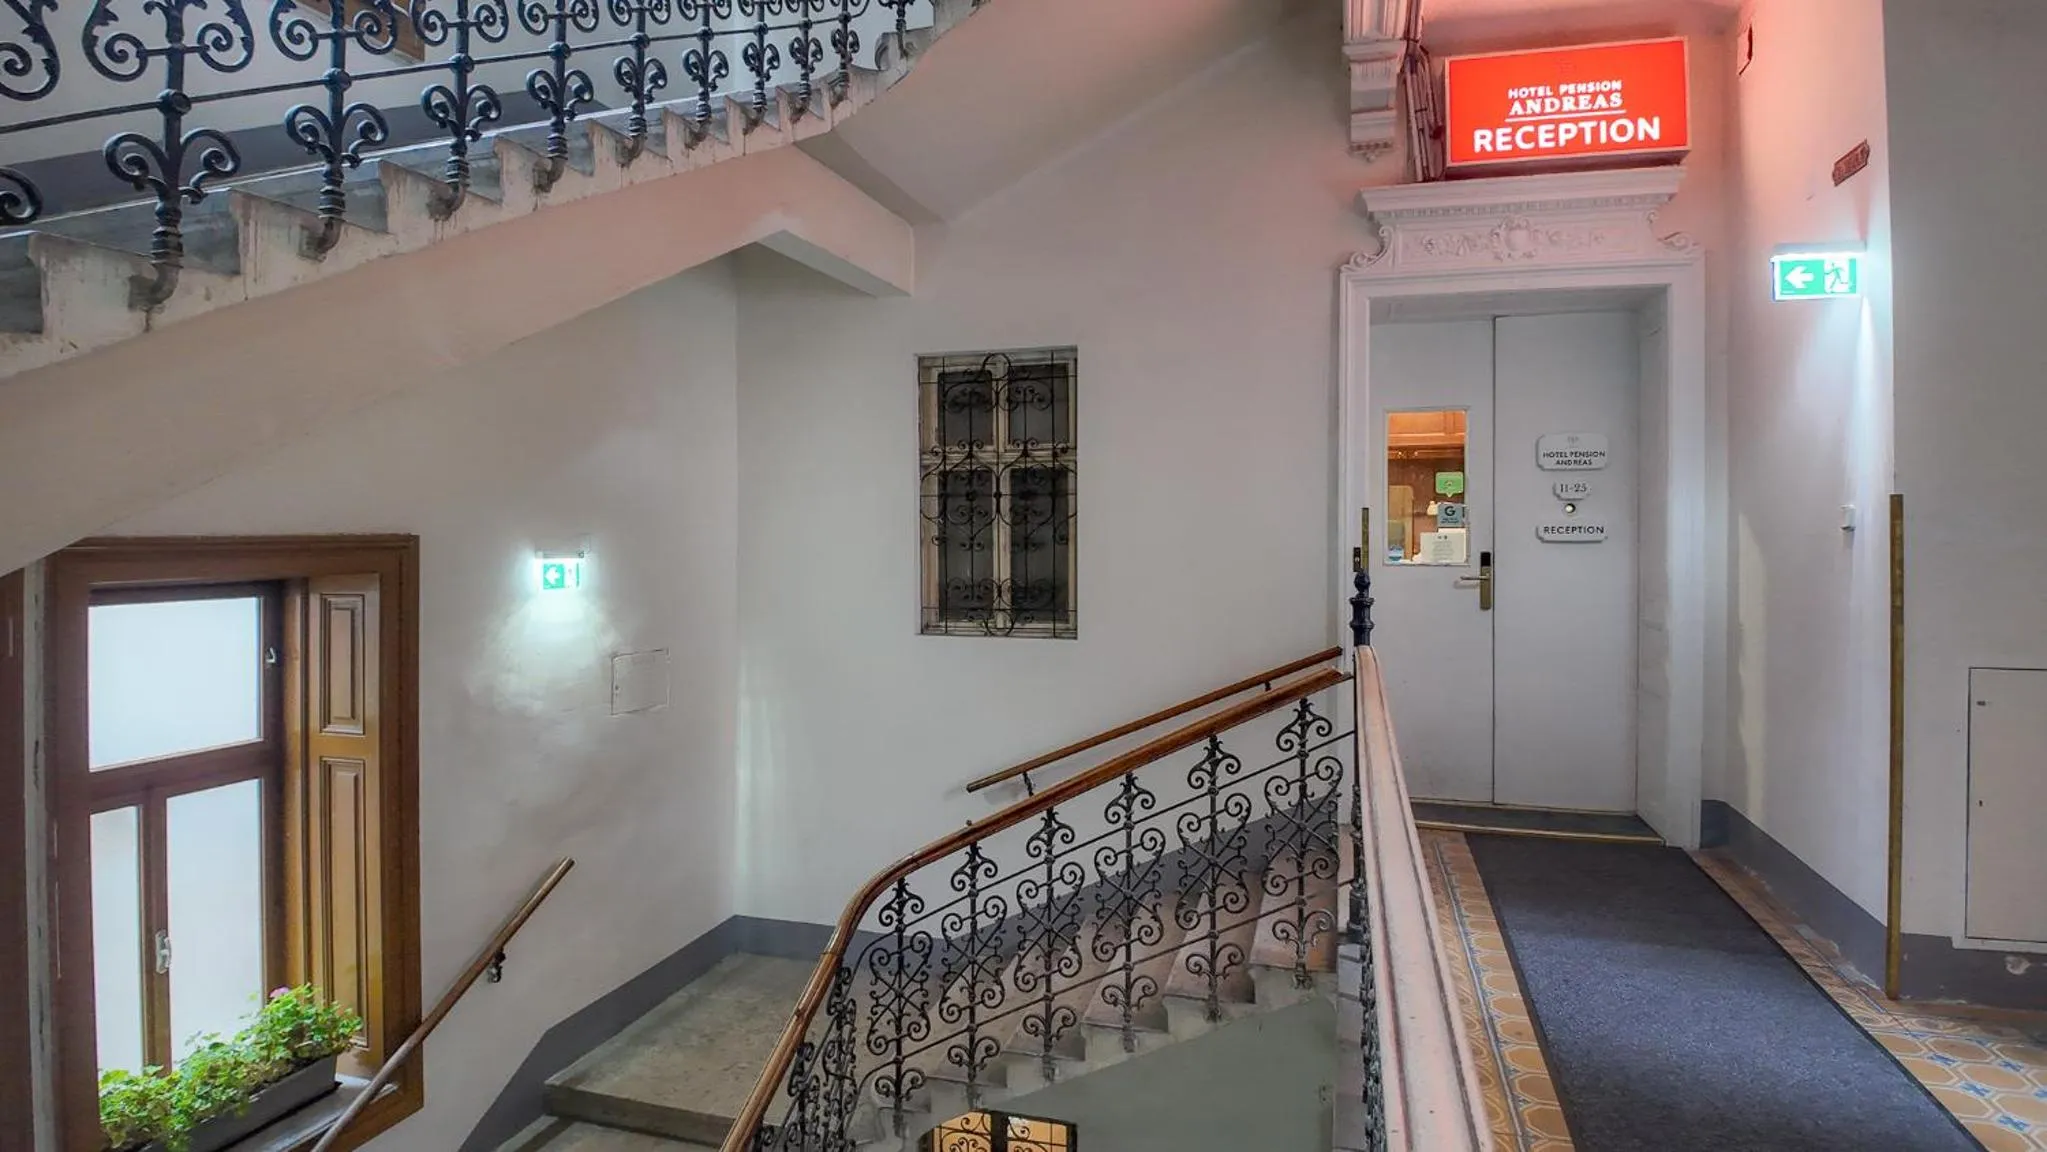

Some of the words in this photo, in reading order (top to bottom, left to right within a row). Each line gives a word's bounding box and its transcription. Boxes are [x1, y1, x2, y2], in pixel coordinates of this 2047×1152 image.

[1508, 85, 1553, 99] HOTEL
[1559, 80, 1622, 95] PENSION
[1508, 92, 1623, 116] ANDREAS
[1473, 116, 1660, 153] RECEPTION
[1542, 451, 1568, 459] HOTEL
[1569, 450, 1606, 458] PENSION
[1543, 526, 1605, 535] RECEPTION
